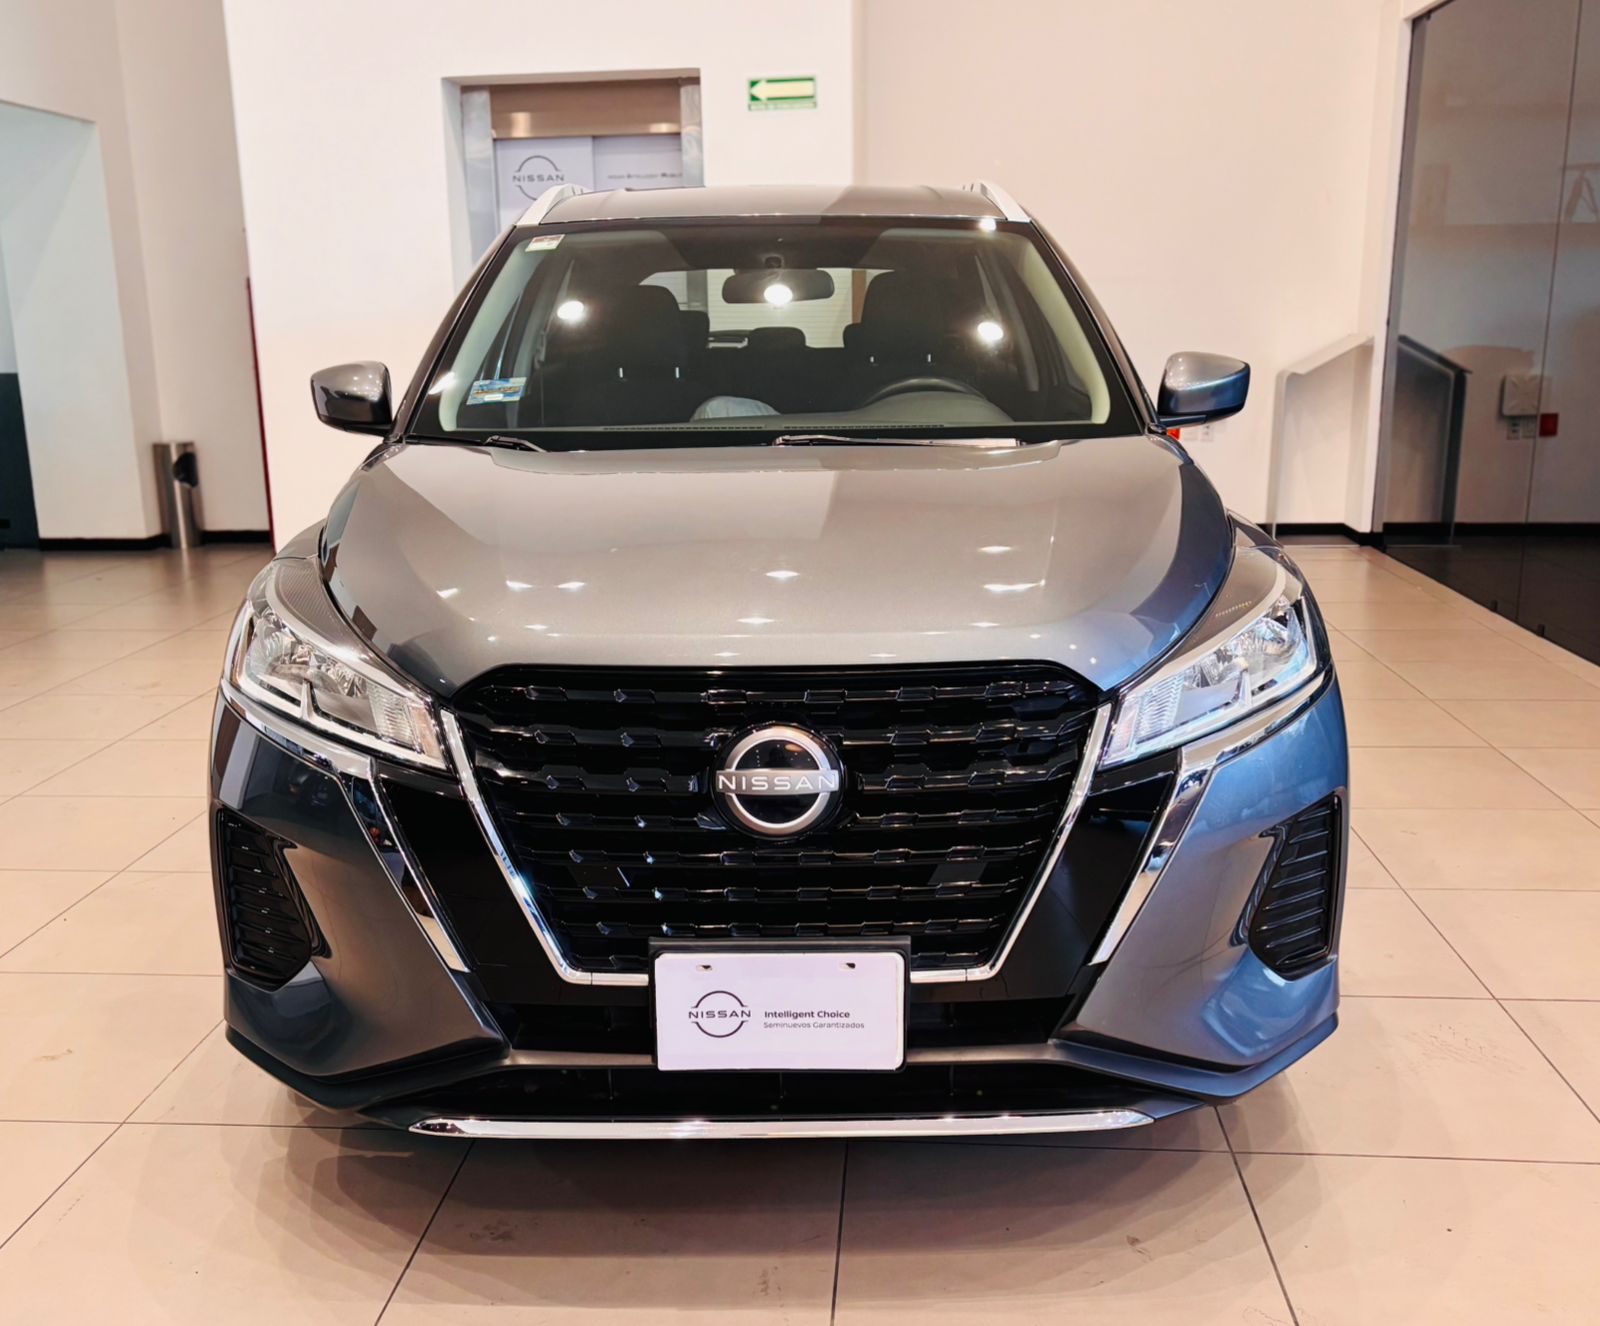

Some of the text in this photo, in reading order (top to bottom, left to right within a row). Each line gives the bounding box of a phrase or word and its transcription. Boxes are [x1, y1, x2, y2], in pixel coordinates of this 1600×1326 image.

[512, 174, 565, 182] NISSAN
[718, 775, 835, 790] NISSAN
[688, 1009, 752, 1019] NISSAN
[764, 1010, 850, 1020] Intelligent Choice
[763, 1021, 865, 1029] Seminuevos Garantizados
